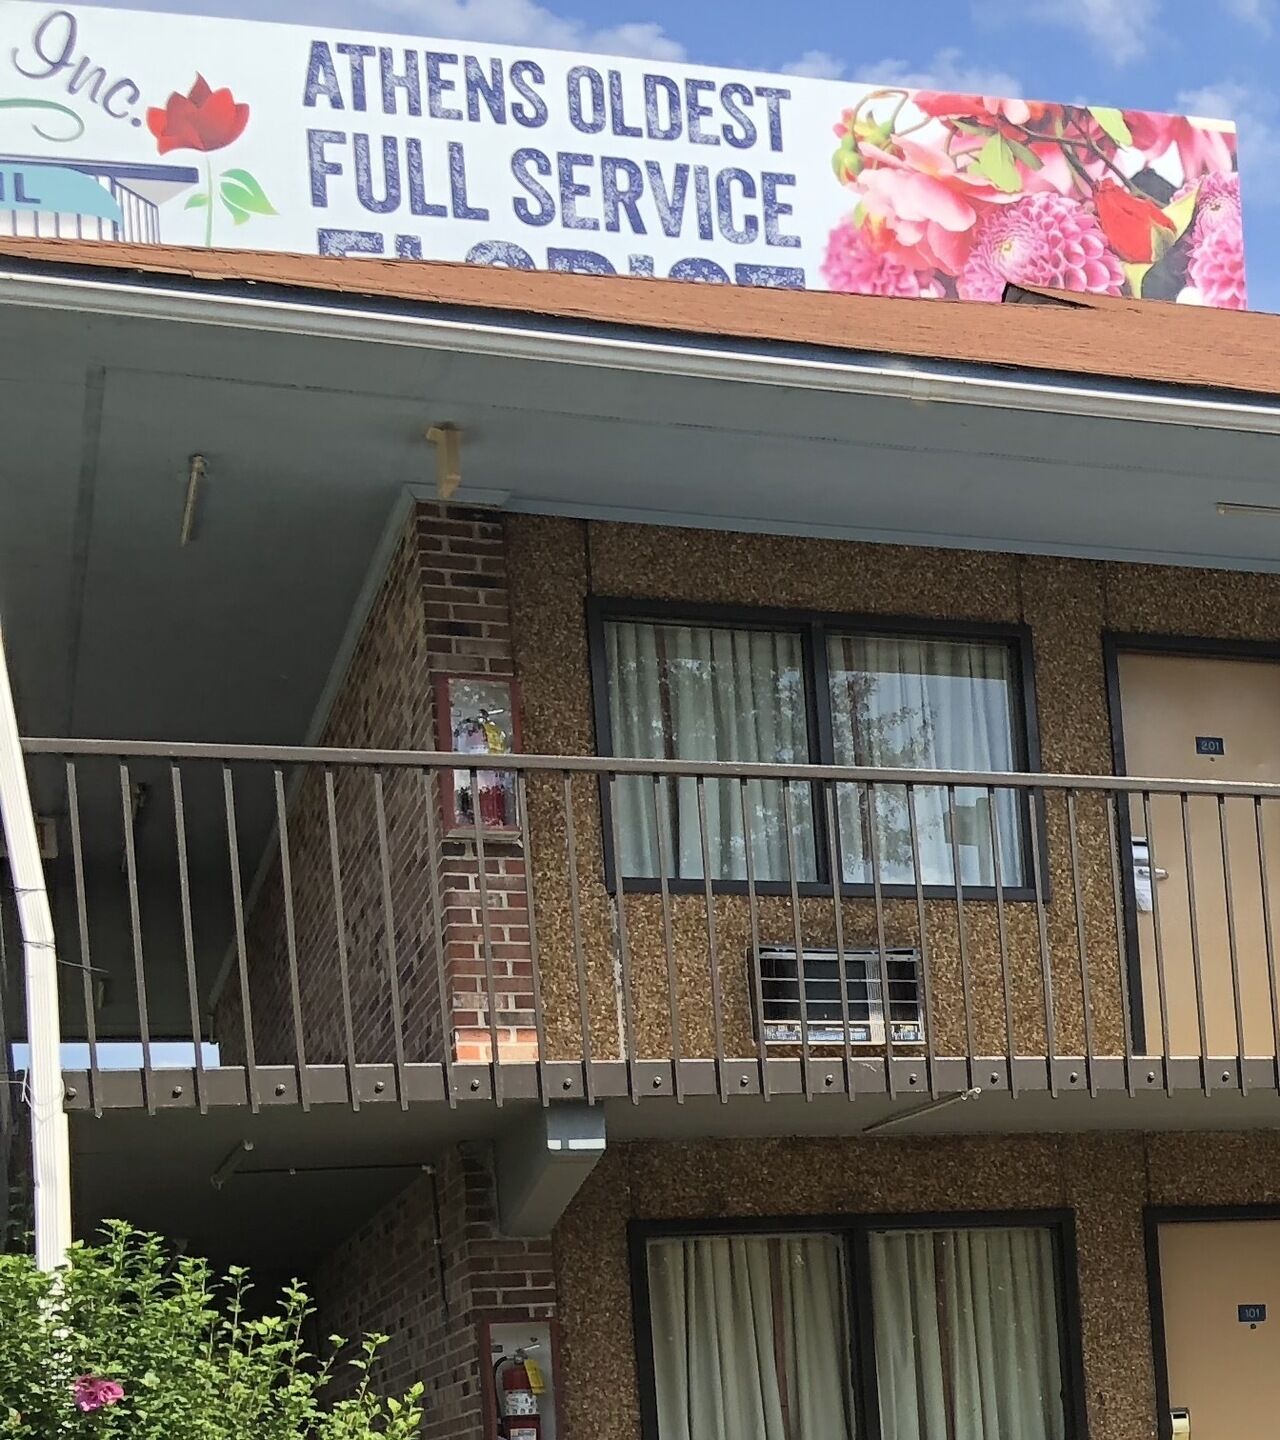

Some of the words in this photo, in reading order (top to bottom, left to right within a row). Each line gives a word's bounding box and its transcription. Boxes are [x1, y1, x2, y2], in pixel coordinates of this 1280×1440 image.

[11, 10, 142, 127] Inc.
[303, 40, 548, 128] ATHENS
[566, 65, 792, 153] OLDEST
[306, 128, 490, 222] FULL
[510, 147, 803, 249] SERVICE
[1200, 740, 1219, 751] 201
